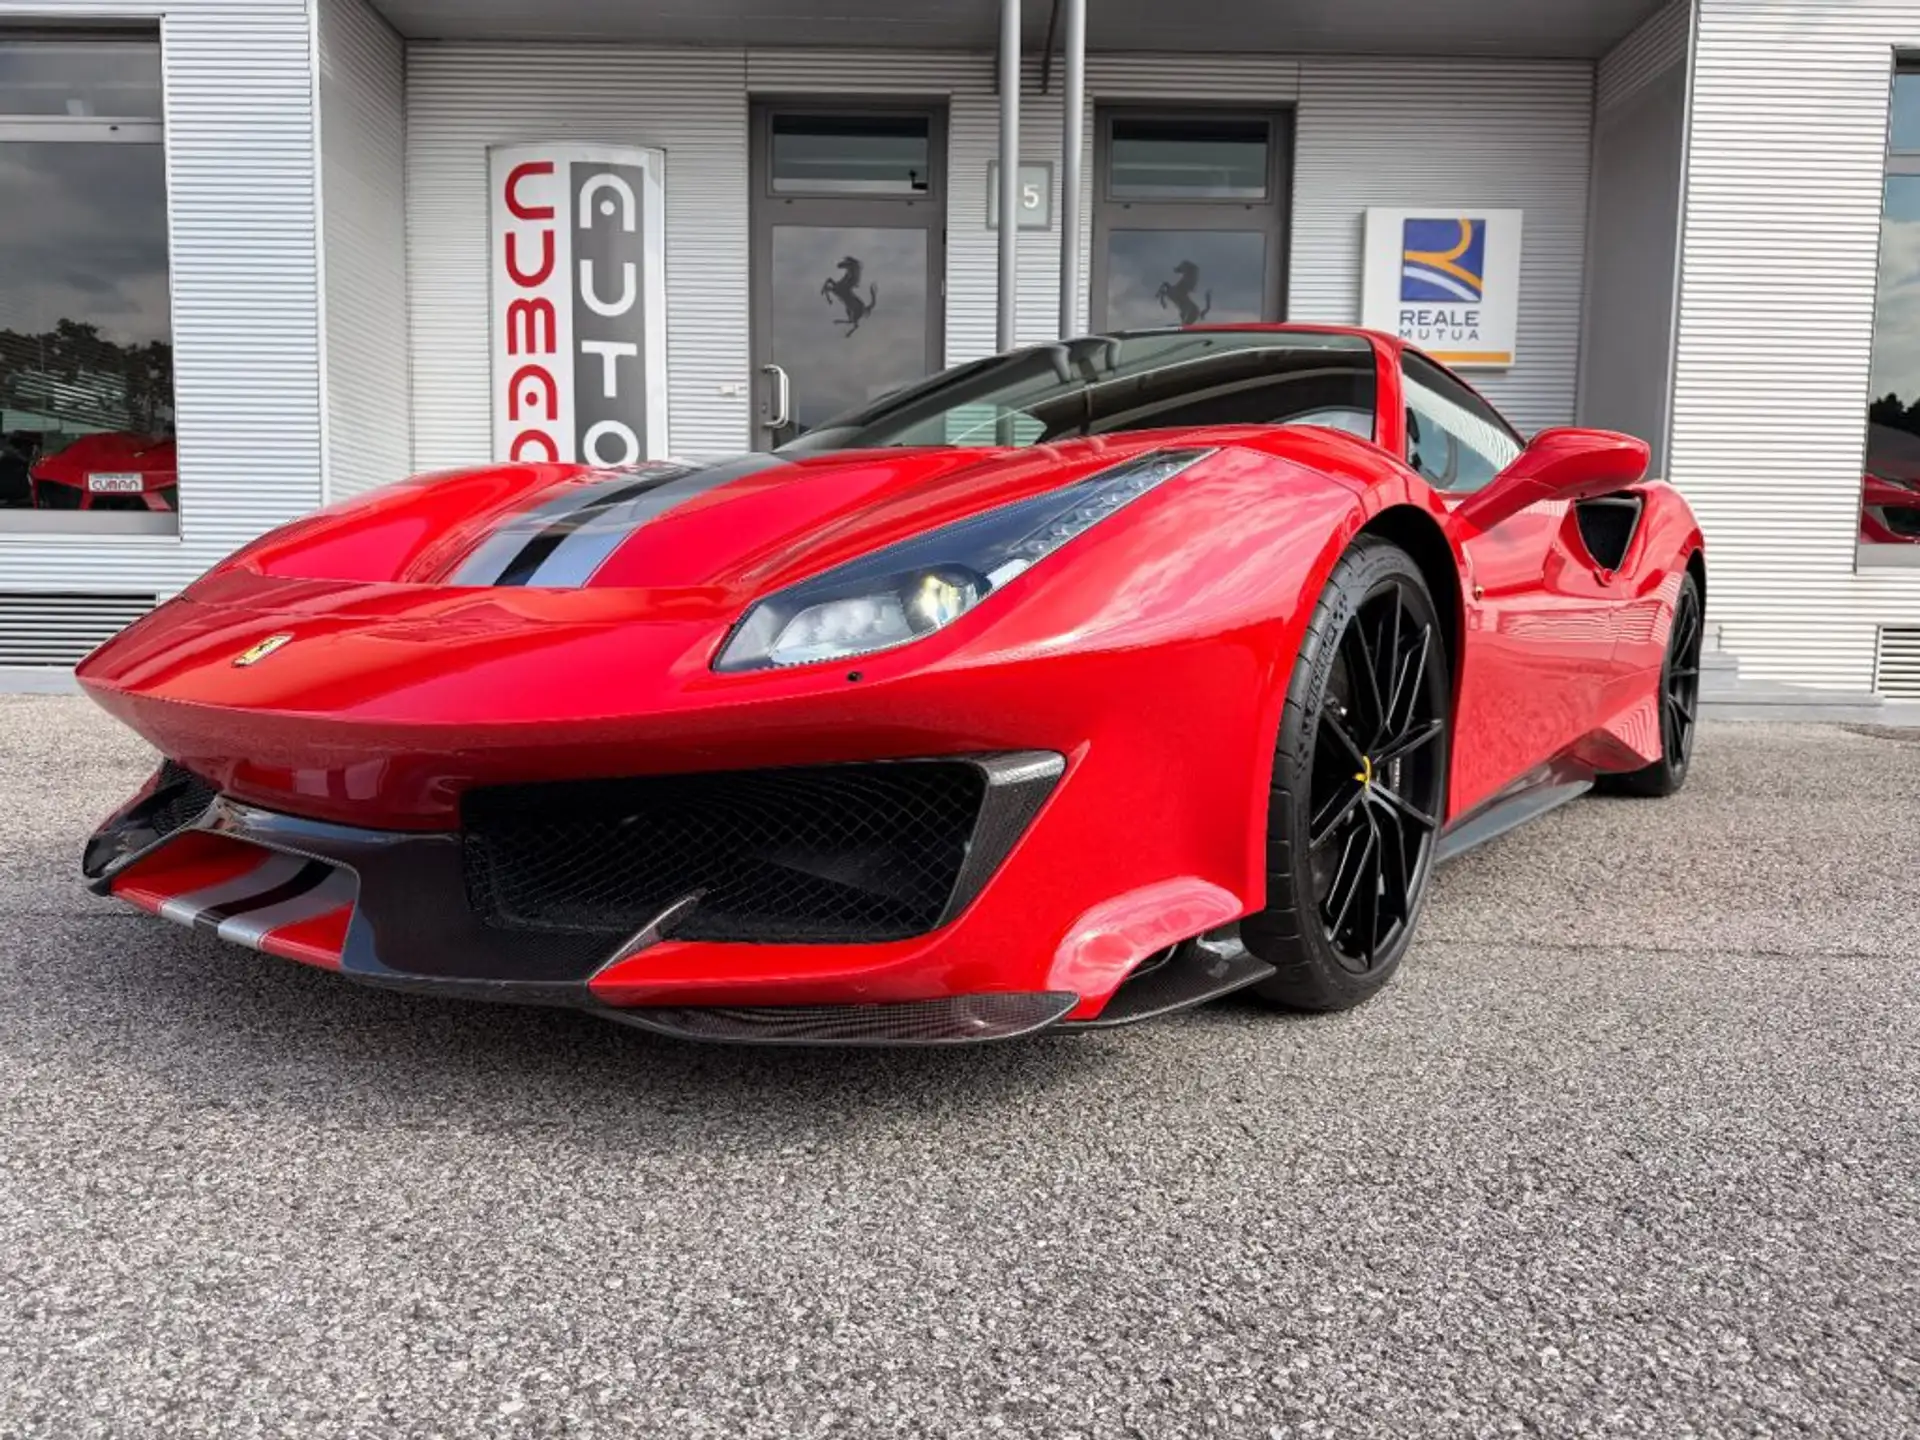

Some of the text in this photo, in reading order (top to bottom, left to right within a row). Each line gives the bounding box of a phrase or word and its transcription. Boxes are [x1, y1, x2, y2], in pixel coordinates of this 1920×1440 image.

[1023, 183, 1040, 209] 5
[579, 172, 639, 468] AUTO
[1400, 309, 1480, 327] REALE
[1400, 328, 1479, 341] MUTUA
